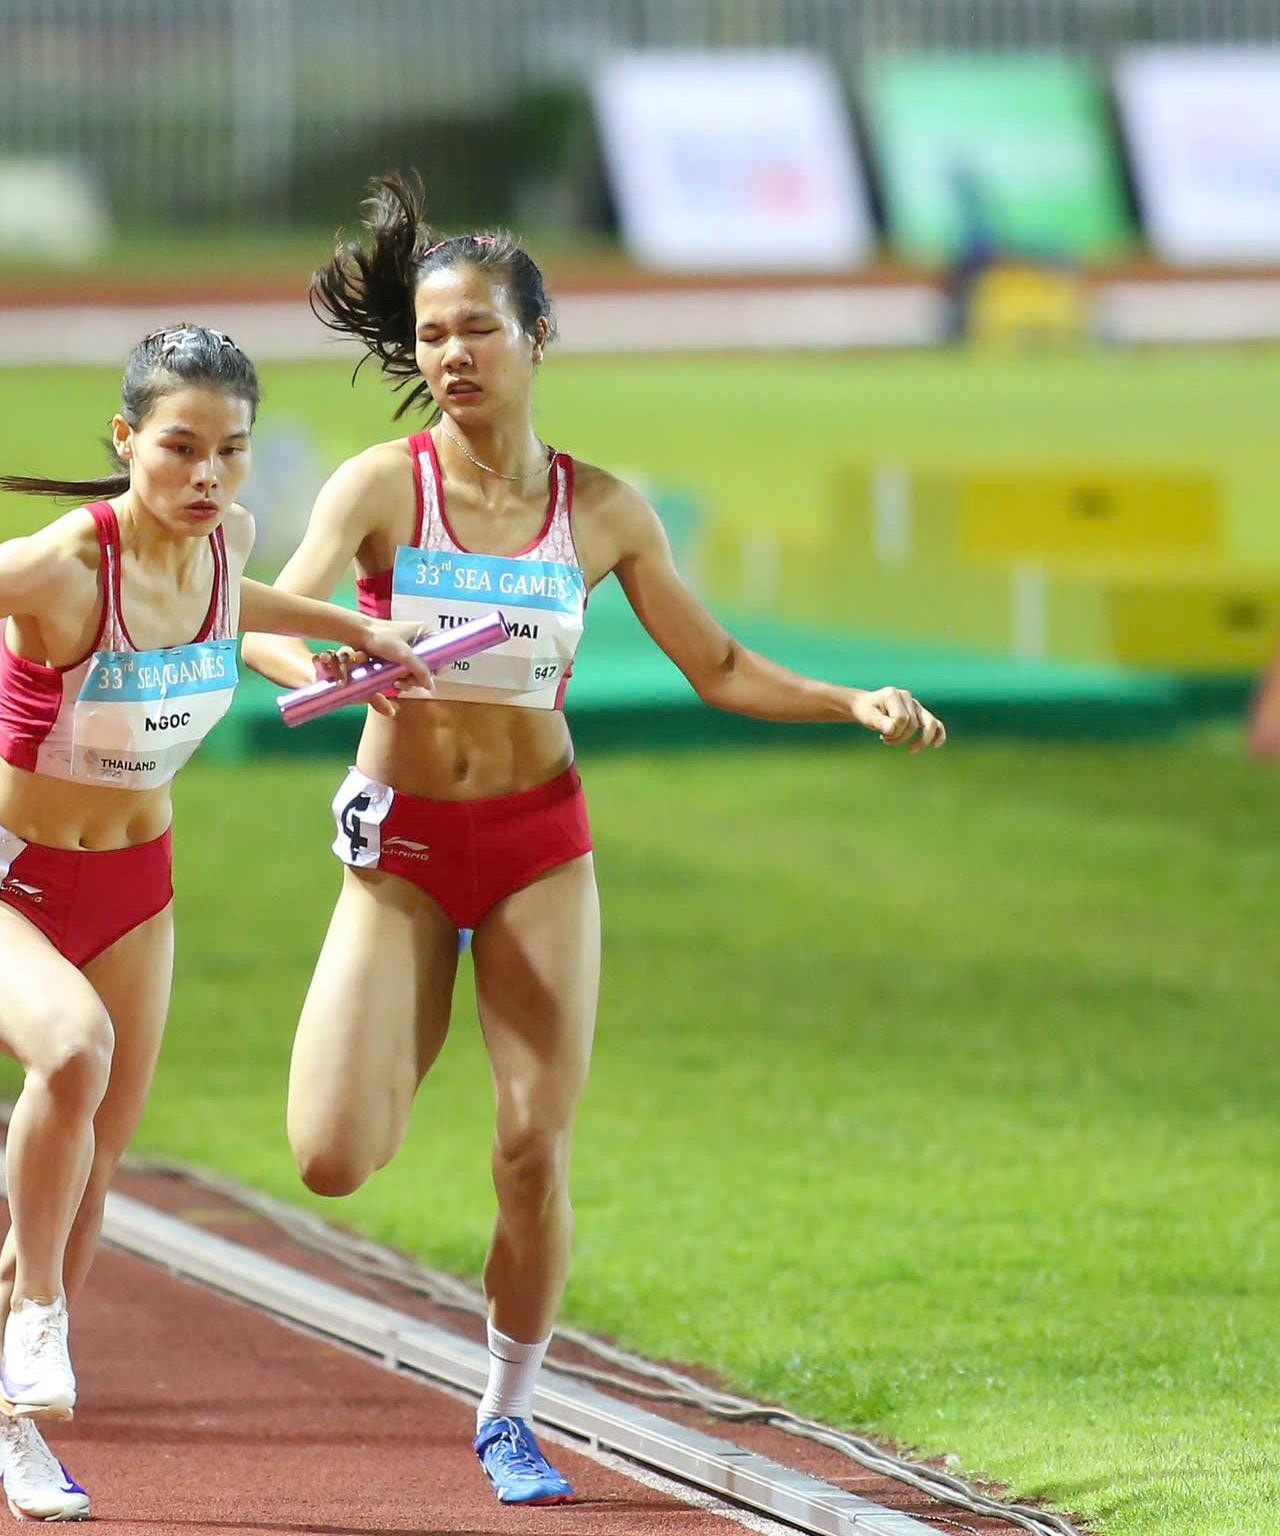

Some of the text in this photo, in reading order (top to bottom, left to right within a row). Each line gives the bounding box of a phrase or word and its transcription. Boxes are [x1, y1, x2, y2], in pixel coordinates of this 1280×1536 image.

[453, 567, 492, 592] SEA
[499, 573, 568, 600] GAMES
[137, 667, 163, 690] SEA
[164, 655, 226, 685] GAMES
[534, 666, 557, 681] 647
[145, 712, 192, 732] NGOC
[100, 758, 157, 771] THAILAND
